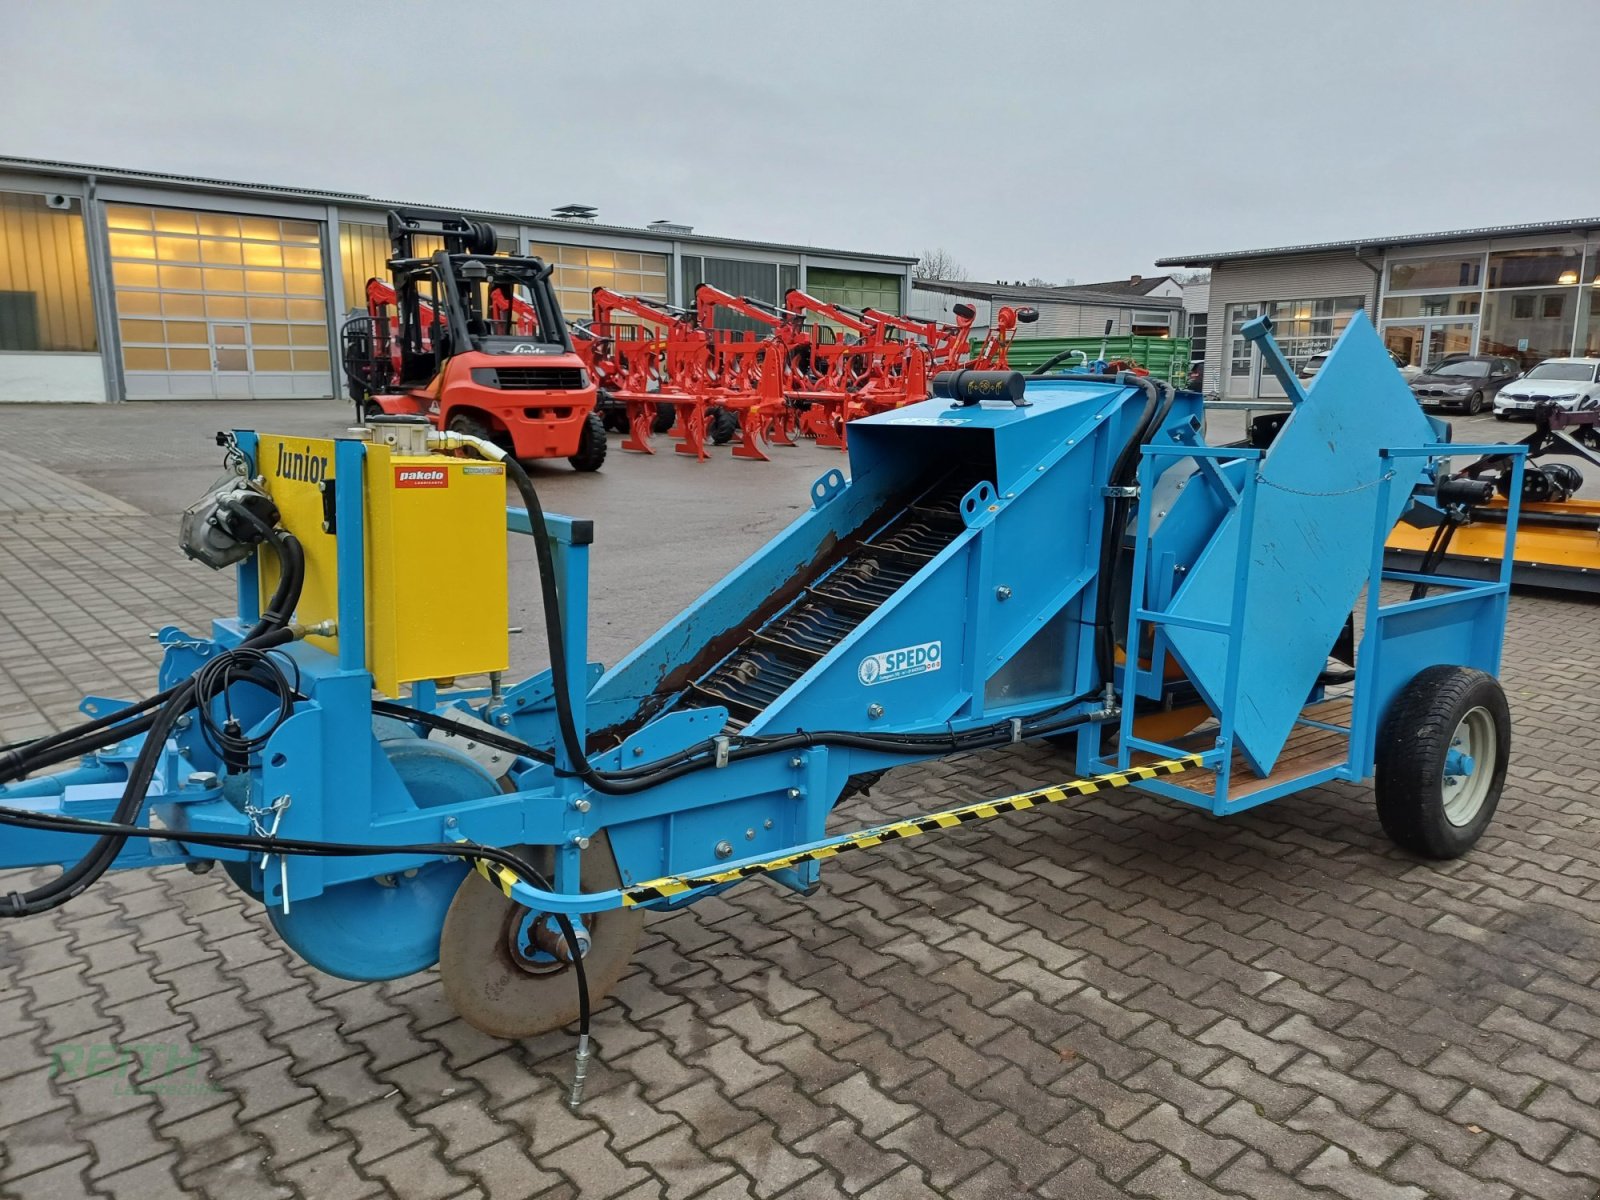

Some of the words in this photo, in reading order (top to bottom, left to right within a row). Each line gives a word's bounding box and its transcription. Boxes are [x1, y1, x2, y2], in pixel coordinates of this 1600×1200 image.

[276, 443, 328, 484] Junior
[400, 471, 444, 481] pakelo
[885, 644, 940, 672] SPEDO
